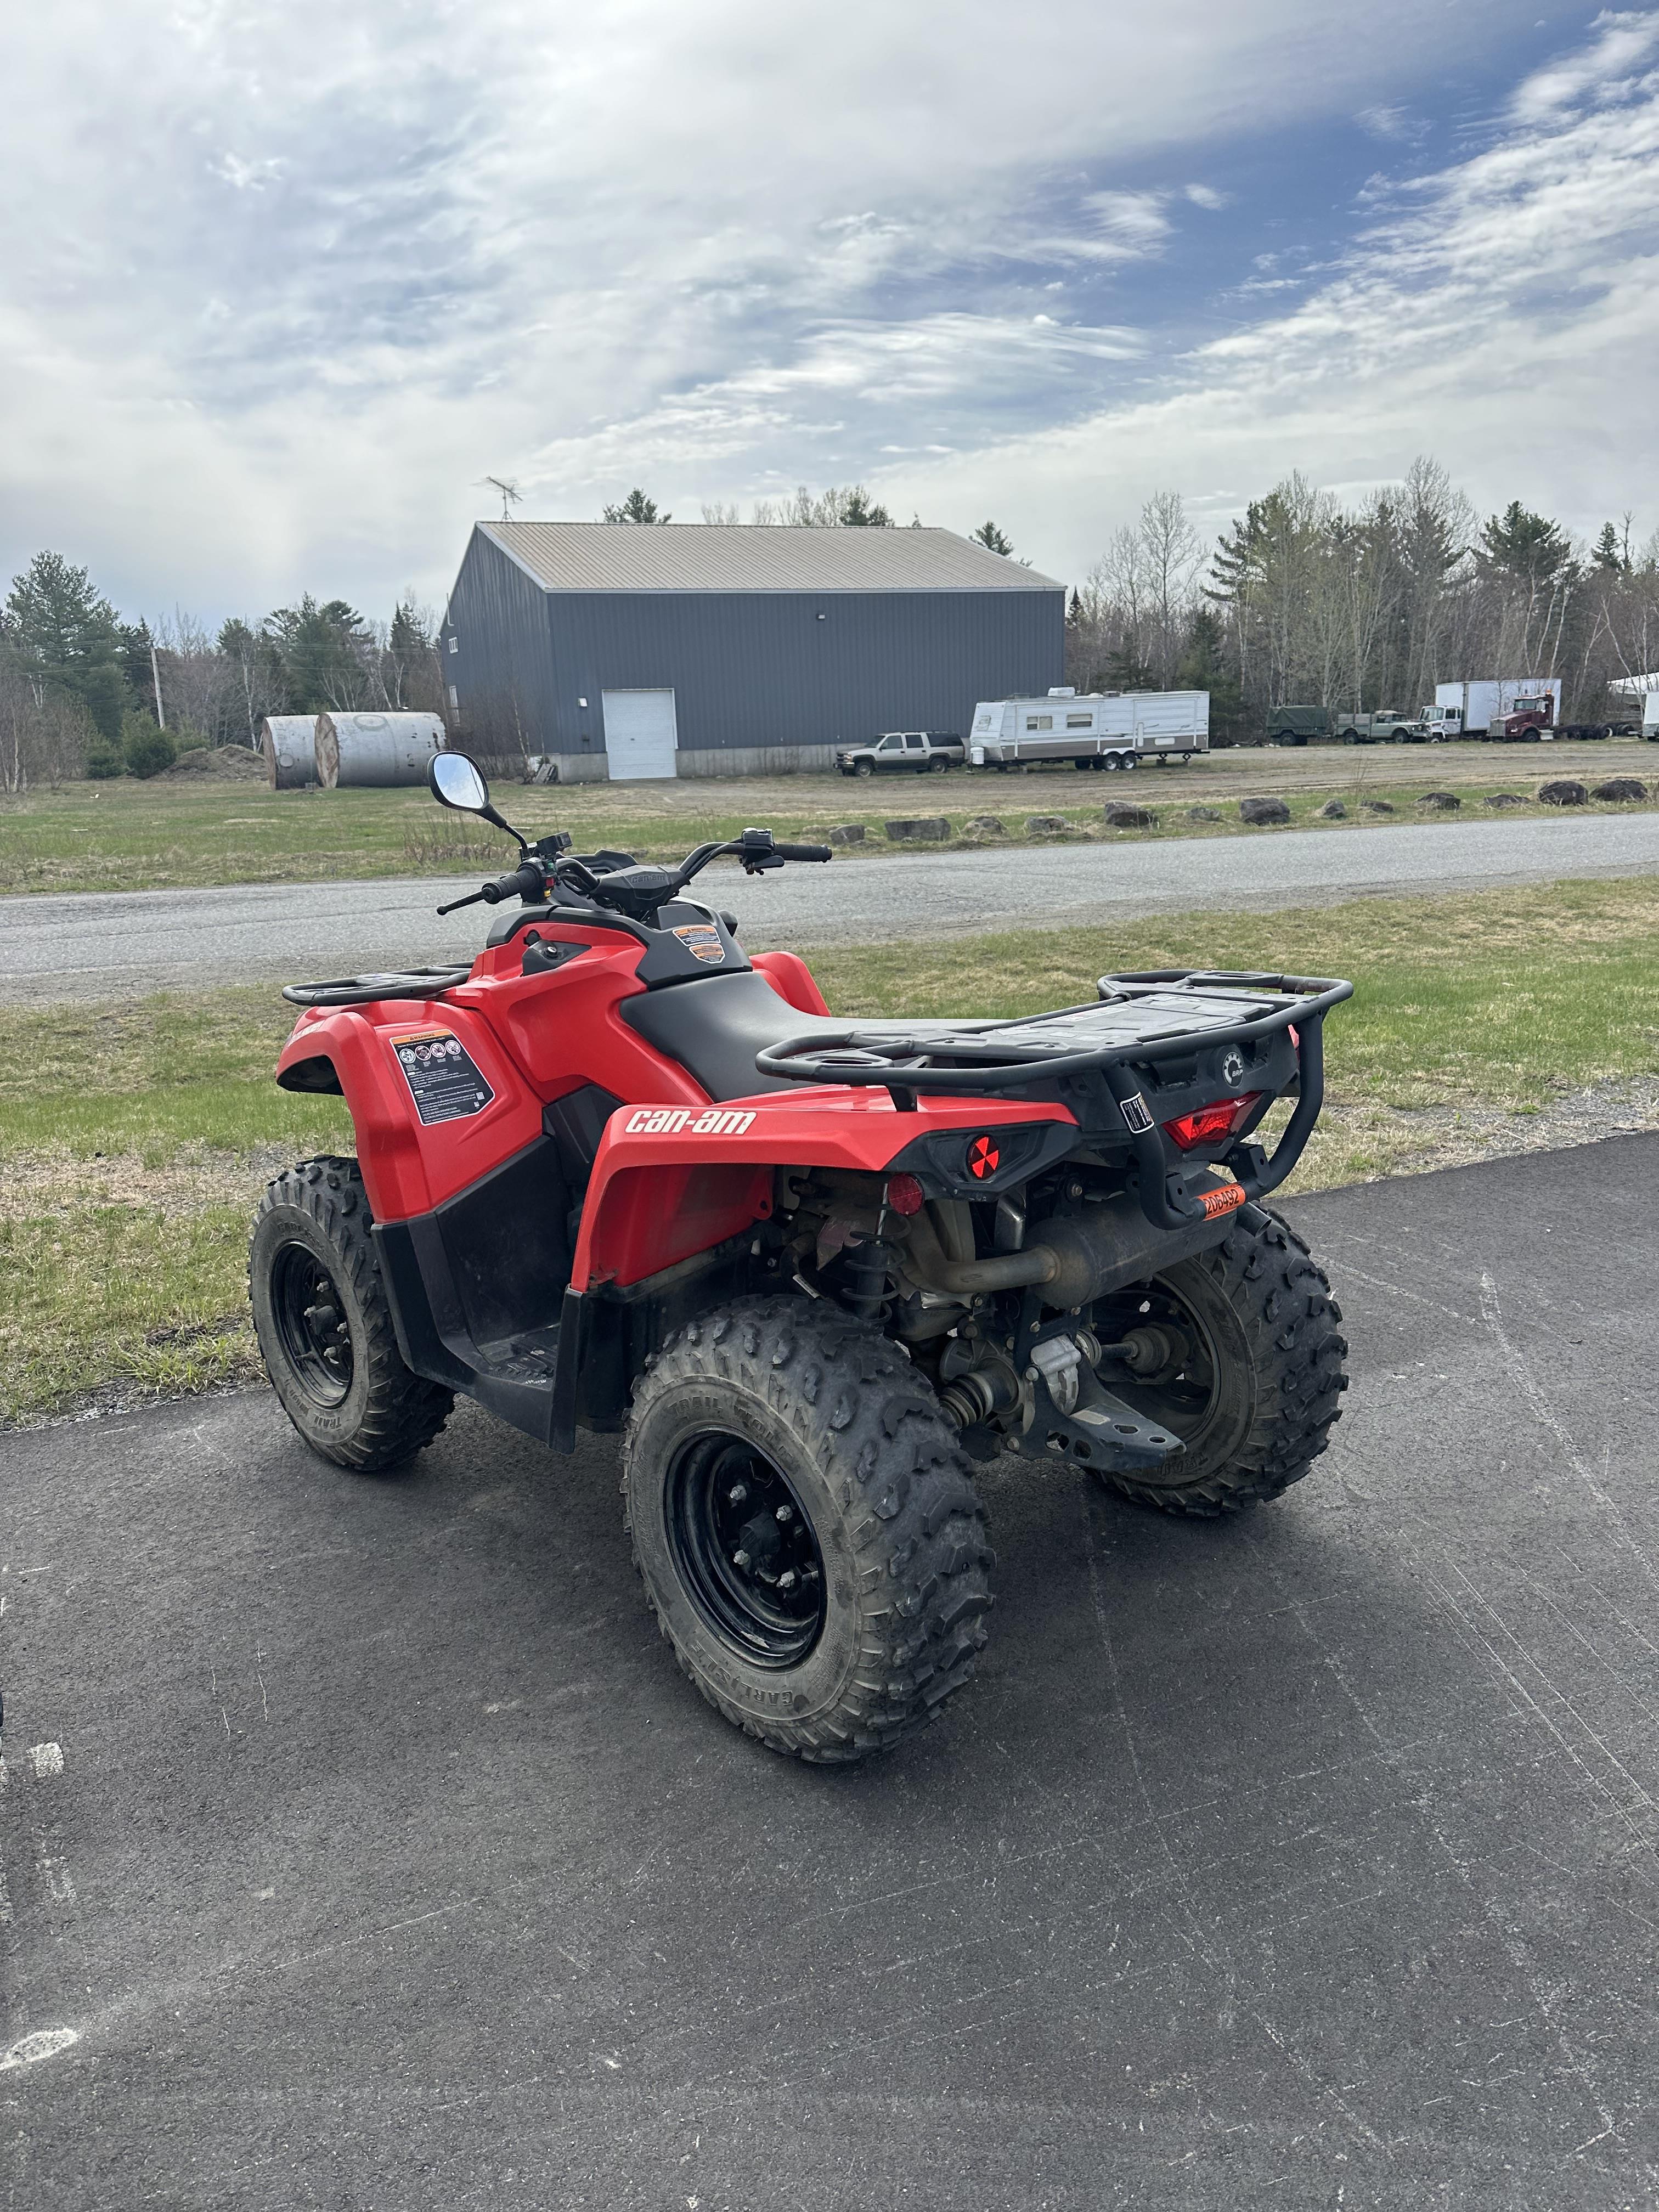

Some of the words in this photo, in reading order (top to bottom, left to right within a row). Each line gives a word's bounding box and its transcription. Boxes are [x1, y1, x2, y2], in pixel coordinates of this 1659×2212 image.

[1232, 1069, 1243, 1077] BRP
[624, 1109, 758, 1135] can-am
[1203, 1188, 1239, 1215] 206492
[667, 1395, 724, 1419] TRAIL
[690, 1639, 793, 1706] CARLISLE
